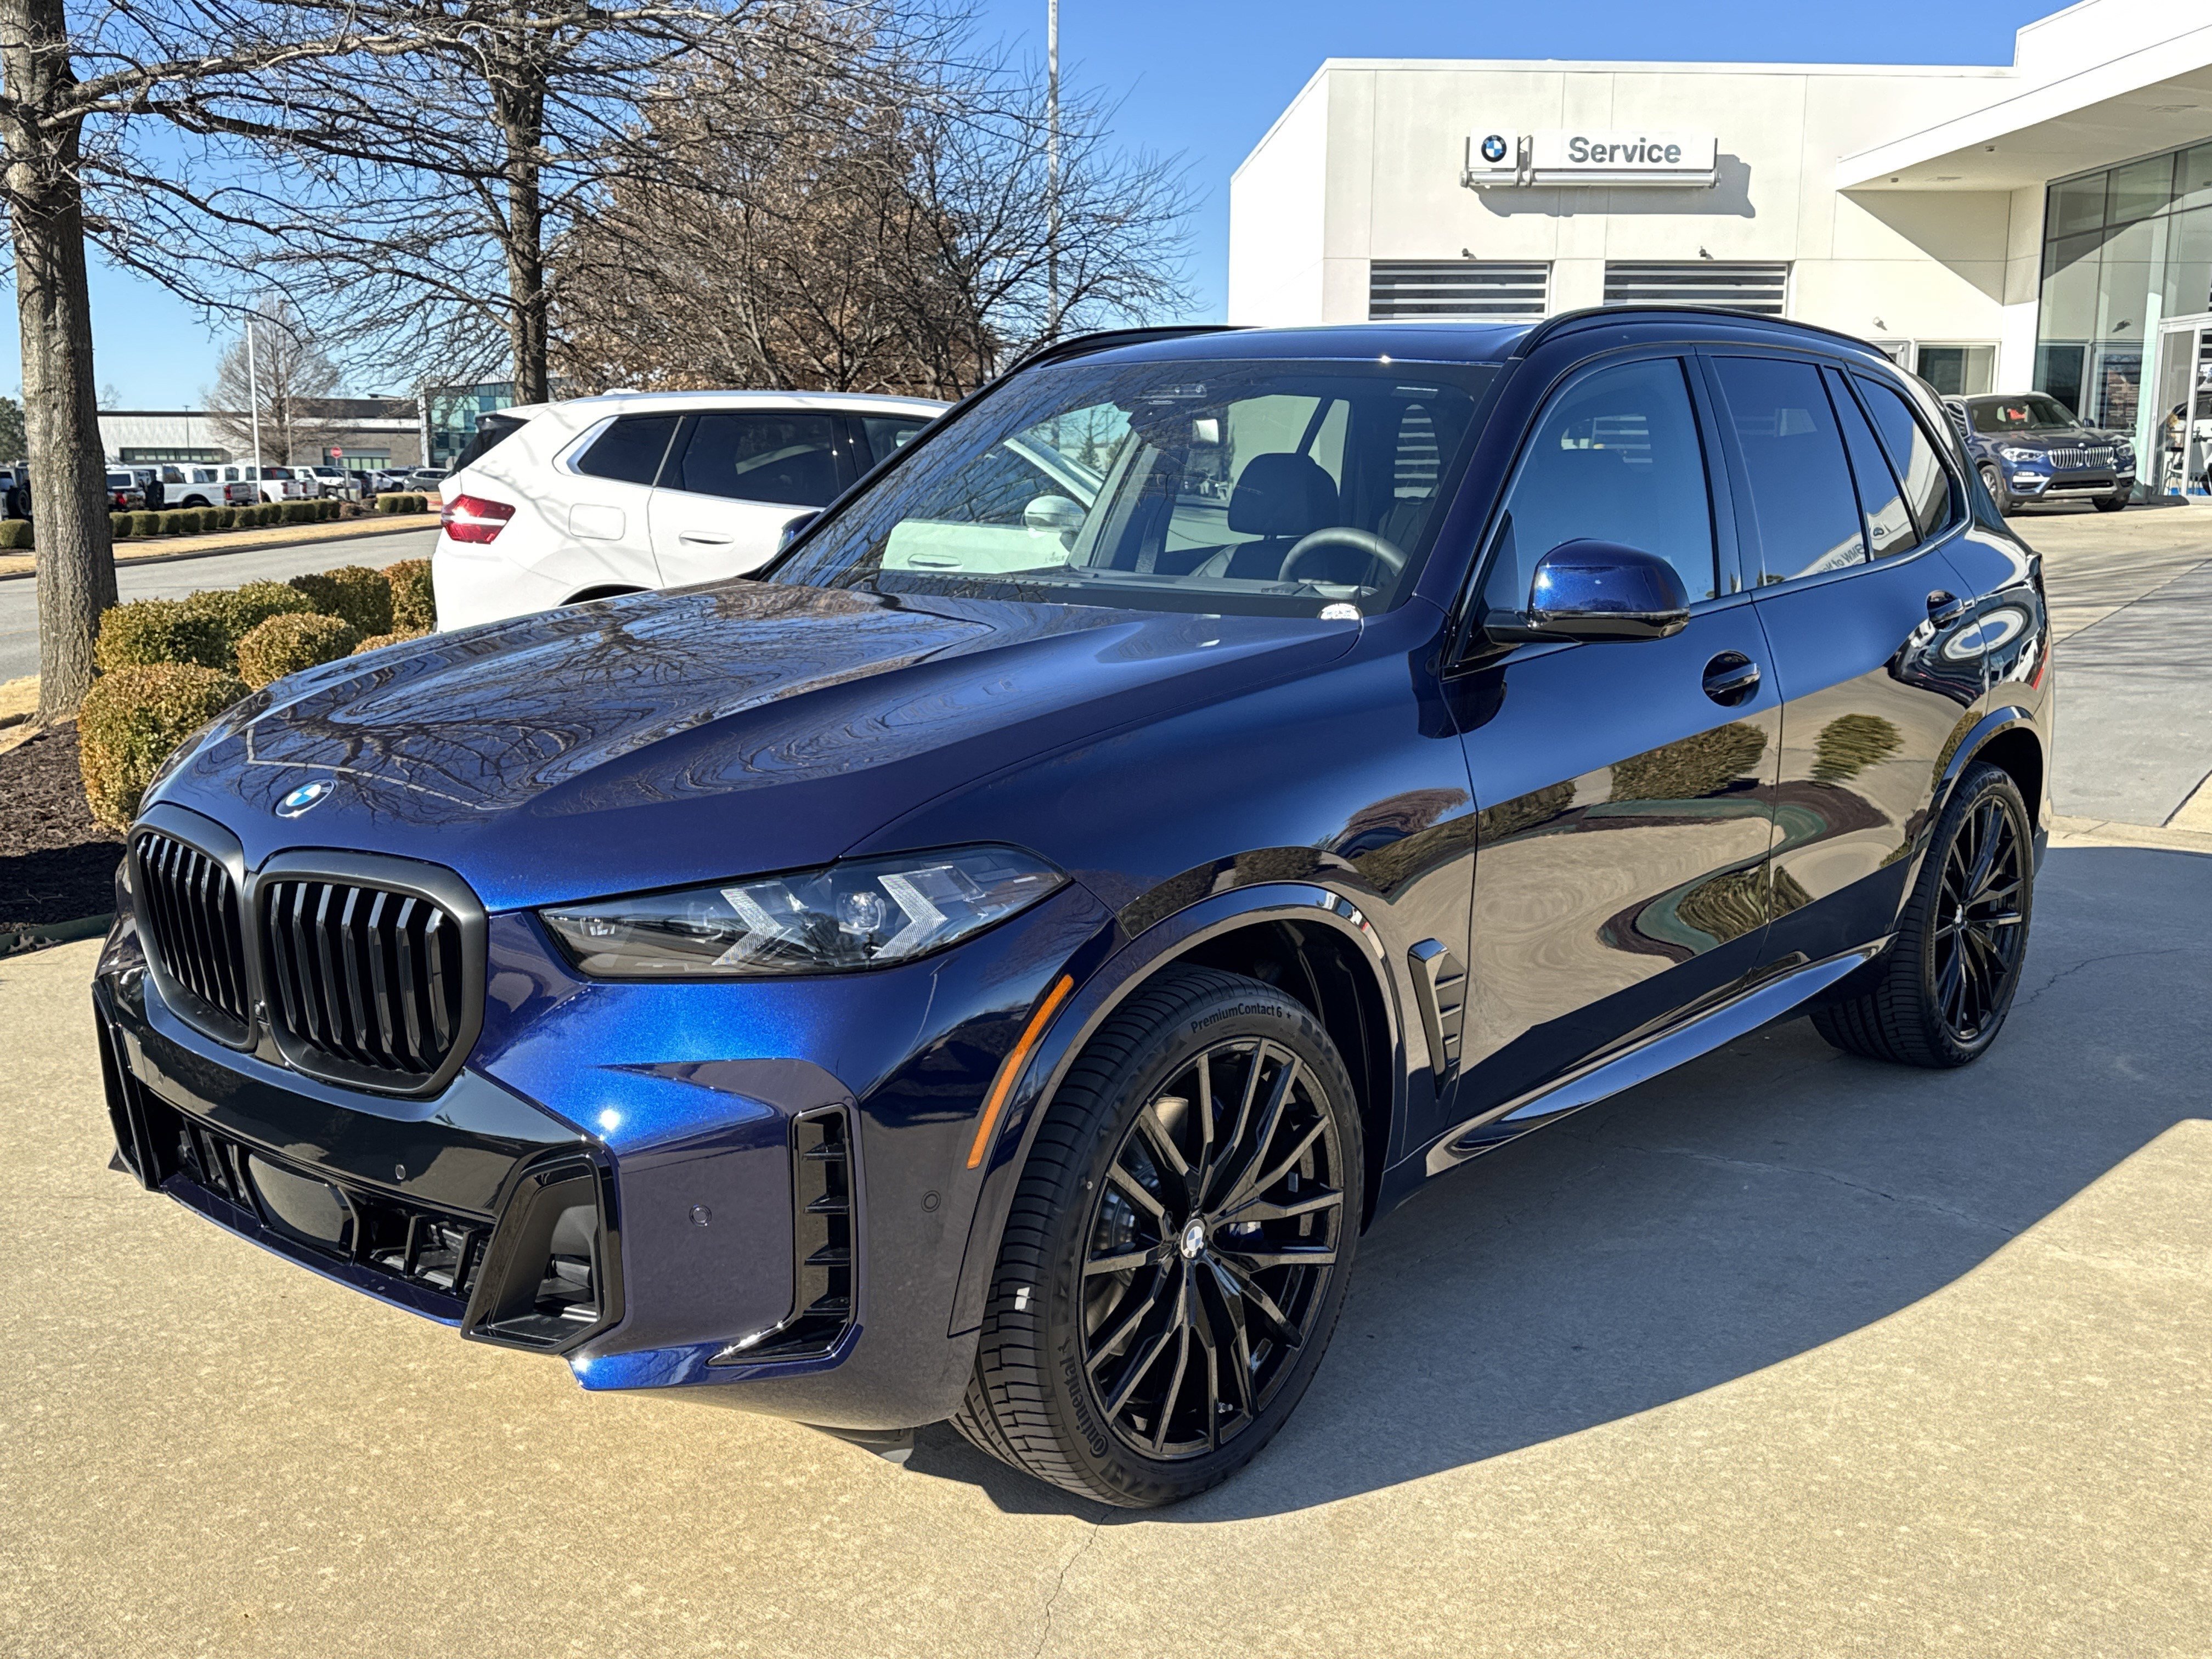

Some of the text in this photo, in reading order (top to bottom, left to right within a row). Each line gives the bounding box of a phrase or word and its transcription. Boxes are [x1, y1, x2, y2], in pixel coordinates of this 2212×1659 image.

[1568, 136, 1681, 163] Service
[1190, 1002, 1275, 1034] PremiumContact
[1276, 1006, 1283, 1018] 6
[1059, 1353, 1108, 1458] Continental
